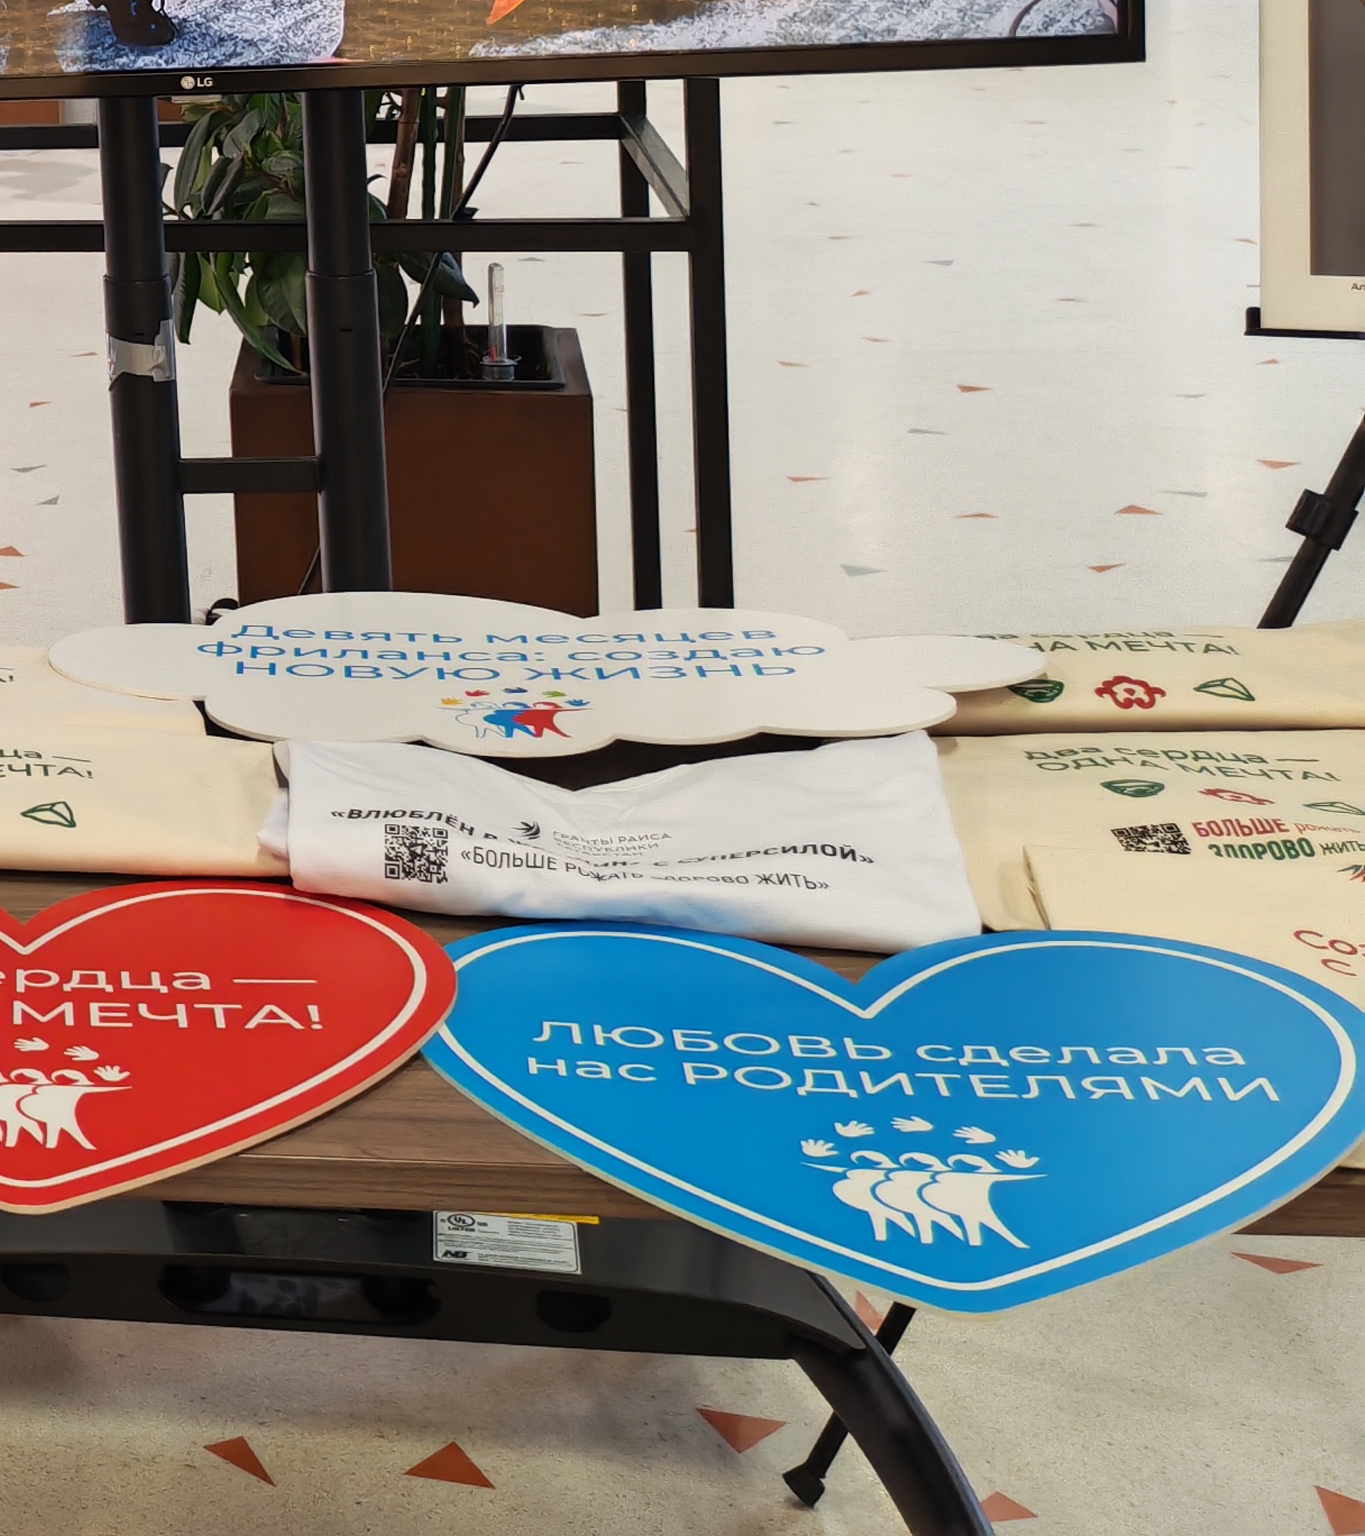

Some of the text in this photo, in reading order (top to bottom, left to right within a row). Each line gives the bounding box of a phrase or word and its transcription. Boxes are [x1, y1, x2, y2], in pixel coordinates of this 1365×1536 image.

[196, 76, 214, 87] LG
[231, 624, 778, 646] Девять месяцев
[197, 641, 826, 662] фриланса: создаю
[1085, 639, 1240, 656] МЕЧТА!
[235, 662, 798, 682] НОВУЮ ЖИЗНЬ
[1024, 745, 1269, 765] Два сердца
[1035, 756, 1343, 783] ОДНА МЕЧТА!
[1191, 817, 1290, 838] БОЛЬШЕ
[755, 873, 830, 892] ЖИТЬ»
[12, 998, 324, 1031] МЕЧТА!
[532, 1019, 1247, 1068] ЛЮБОВЬ сделала
[526, 1055, 1282, 1104] нас РОДИТЕЛЯМИ
